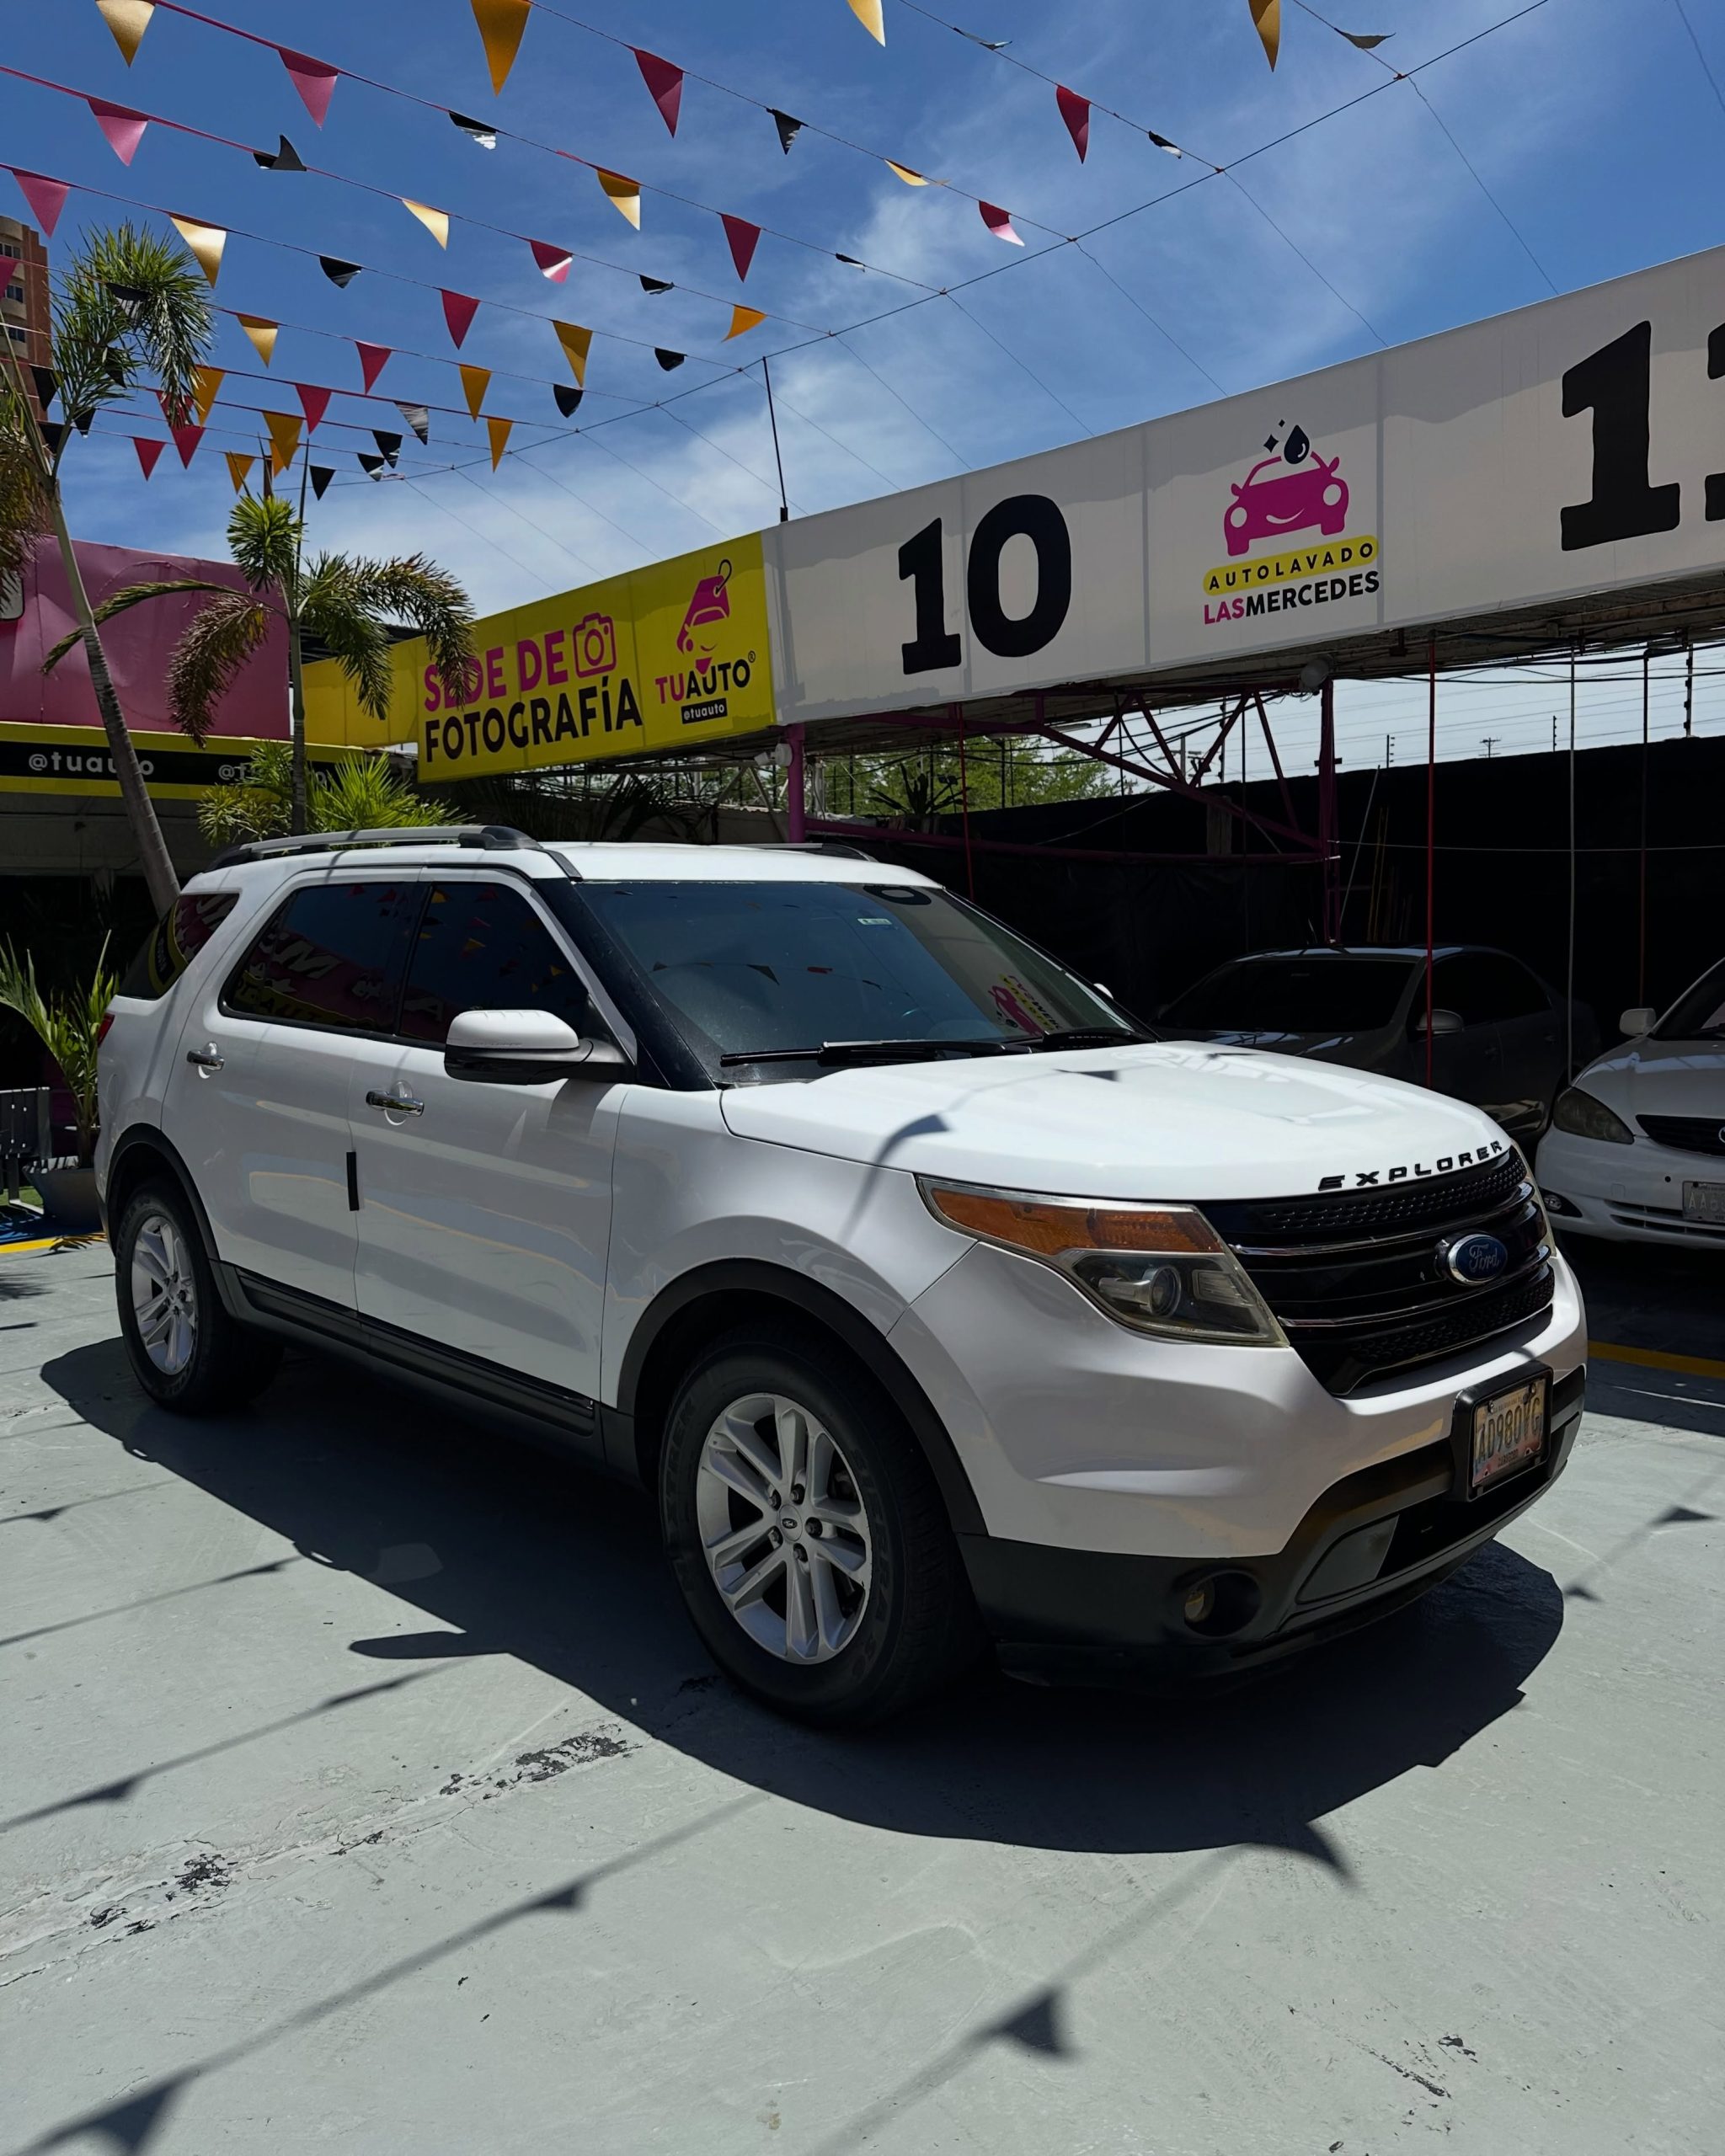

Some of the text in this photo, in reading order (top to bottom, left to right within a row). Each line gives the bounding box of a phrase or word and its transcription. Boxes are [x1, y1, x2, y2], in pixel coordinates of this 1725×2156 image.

[1561, 321, 1725, 552] 1
[898, 494, 1072, 675] 10
[1209, 542, 1374, 590] AUTOLAVADO
[516, 629, 569, 692] DE
[425, 675, 644, 763] FOTOGRAFÍA
[28, 750, 155, 776] @tuauo
[1317, 1140, 1503, 1192] EXPLORER
[1468, 1243, 1502, 1273] Ford
